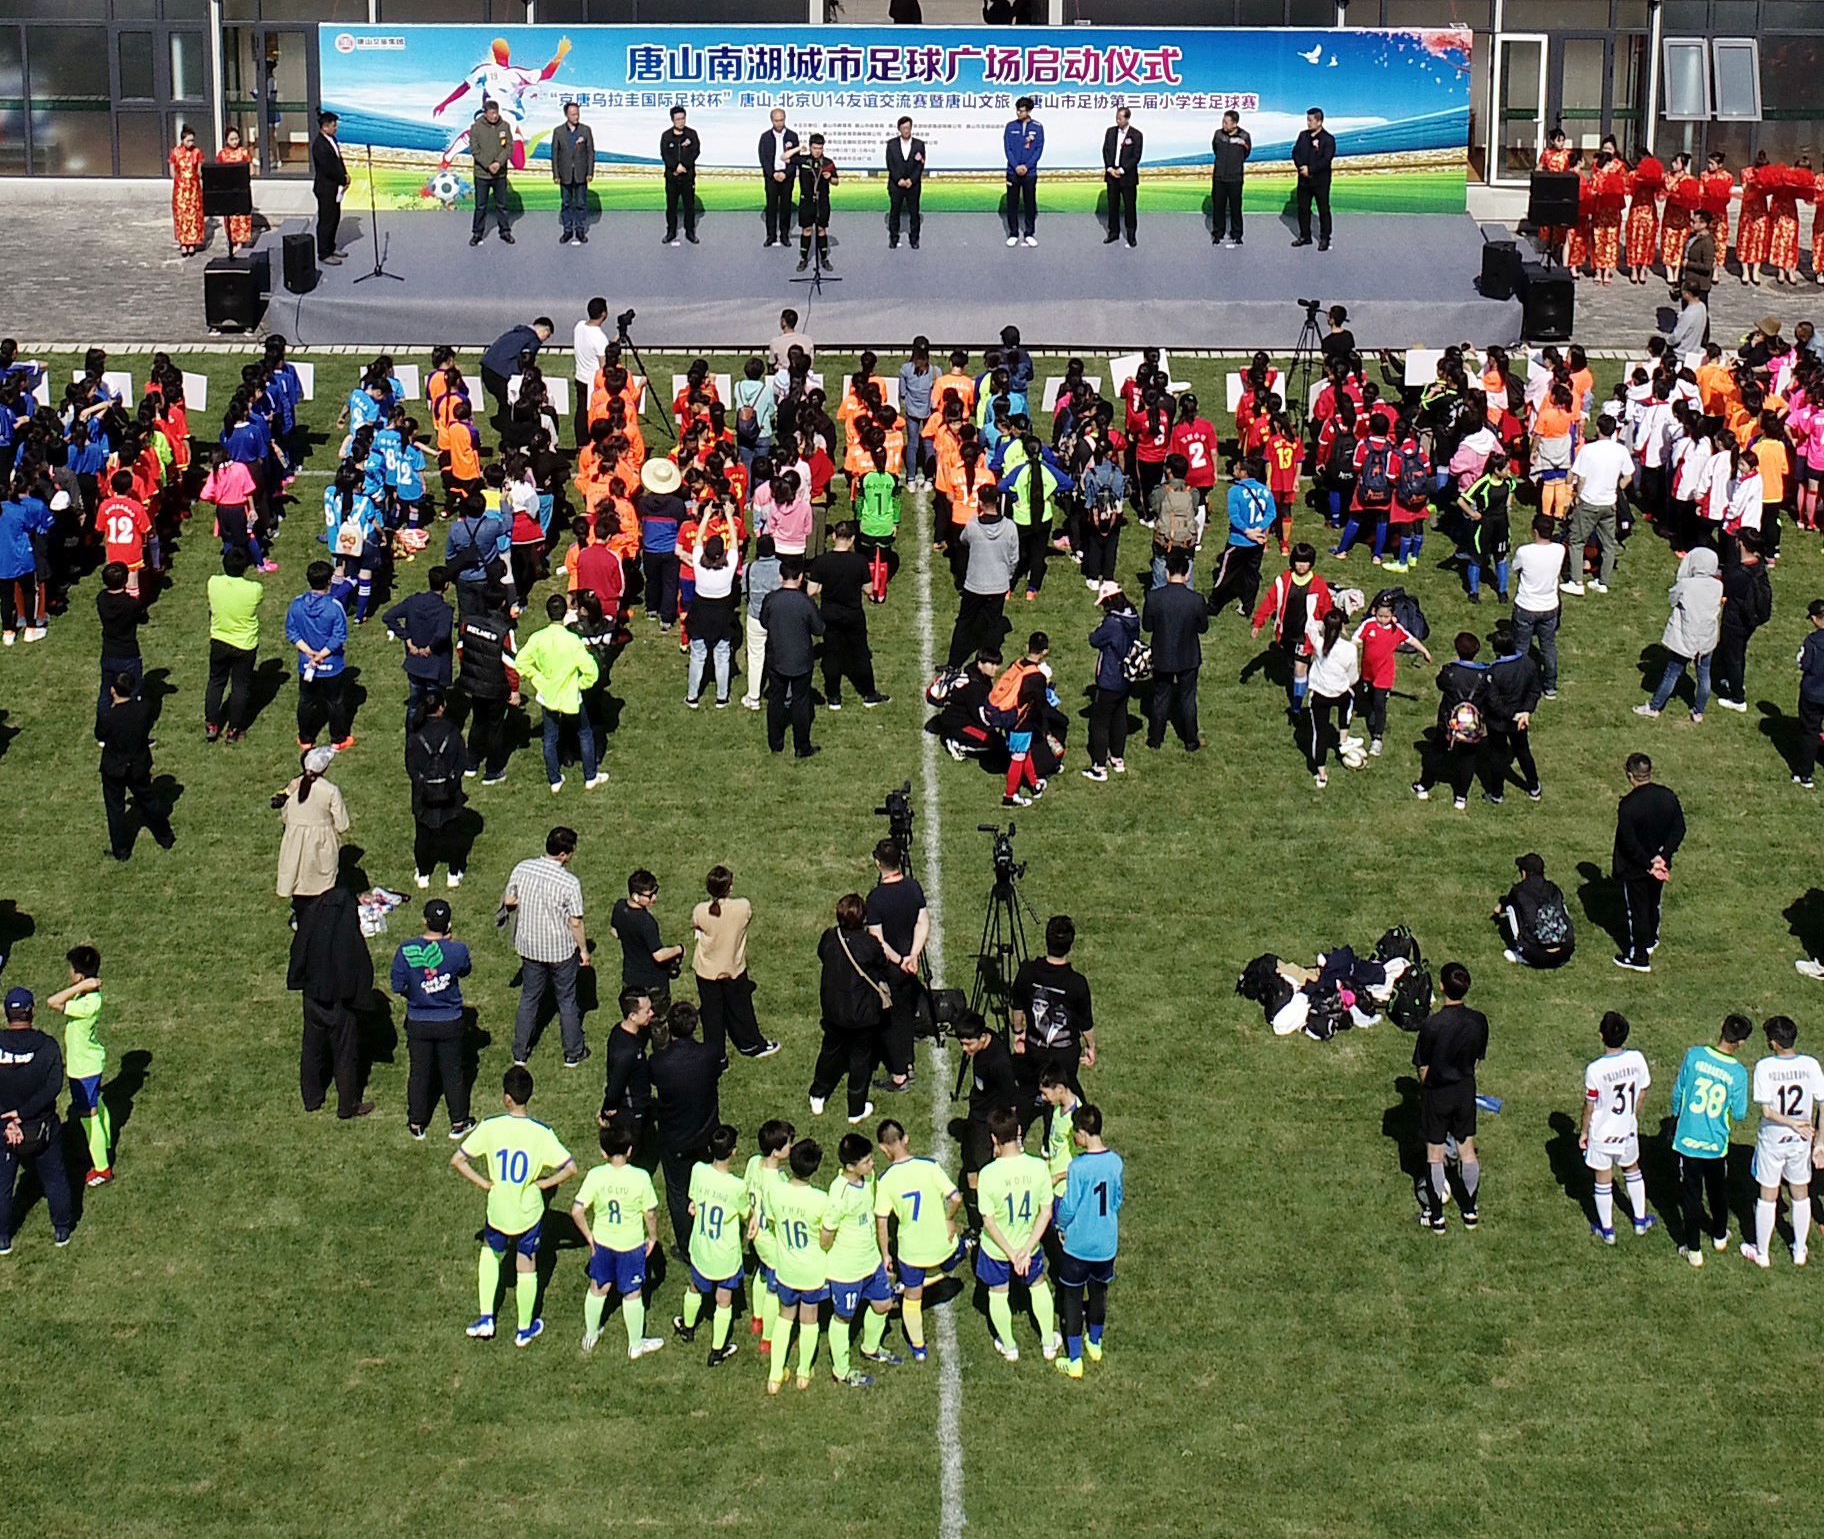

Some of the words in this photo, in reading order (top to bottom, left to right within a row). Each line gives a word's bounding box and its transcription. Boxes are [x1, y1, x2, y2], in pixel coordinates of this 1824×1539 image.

[625, 46, 1181, 84] 唐山南湖城市足球广场启动仪式
[1188, 442, 1207, 469] 2
[1275, 447, 1293, 470] 13
[395, 461, 412, 485] 12
[108, 516, 133, 543] 12
[1612, 1082, 1636, 1116] 31
[1689, 1075, 1726, 1118] 38
[1777, 1084, 1803, 1116] 12
[496, 1147, 529, 1184] 10
[608, 1199, 622, 1224] 8
[902, 1188, 922, 1220] 7
[1005, 1191, 1032, 1226] 14
[1093, 1181, 1107, 1216] 1
[698, 1200, 724, 1240] 19
[783, 1218, 809, 1250] 16
